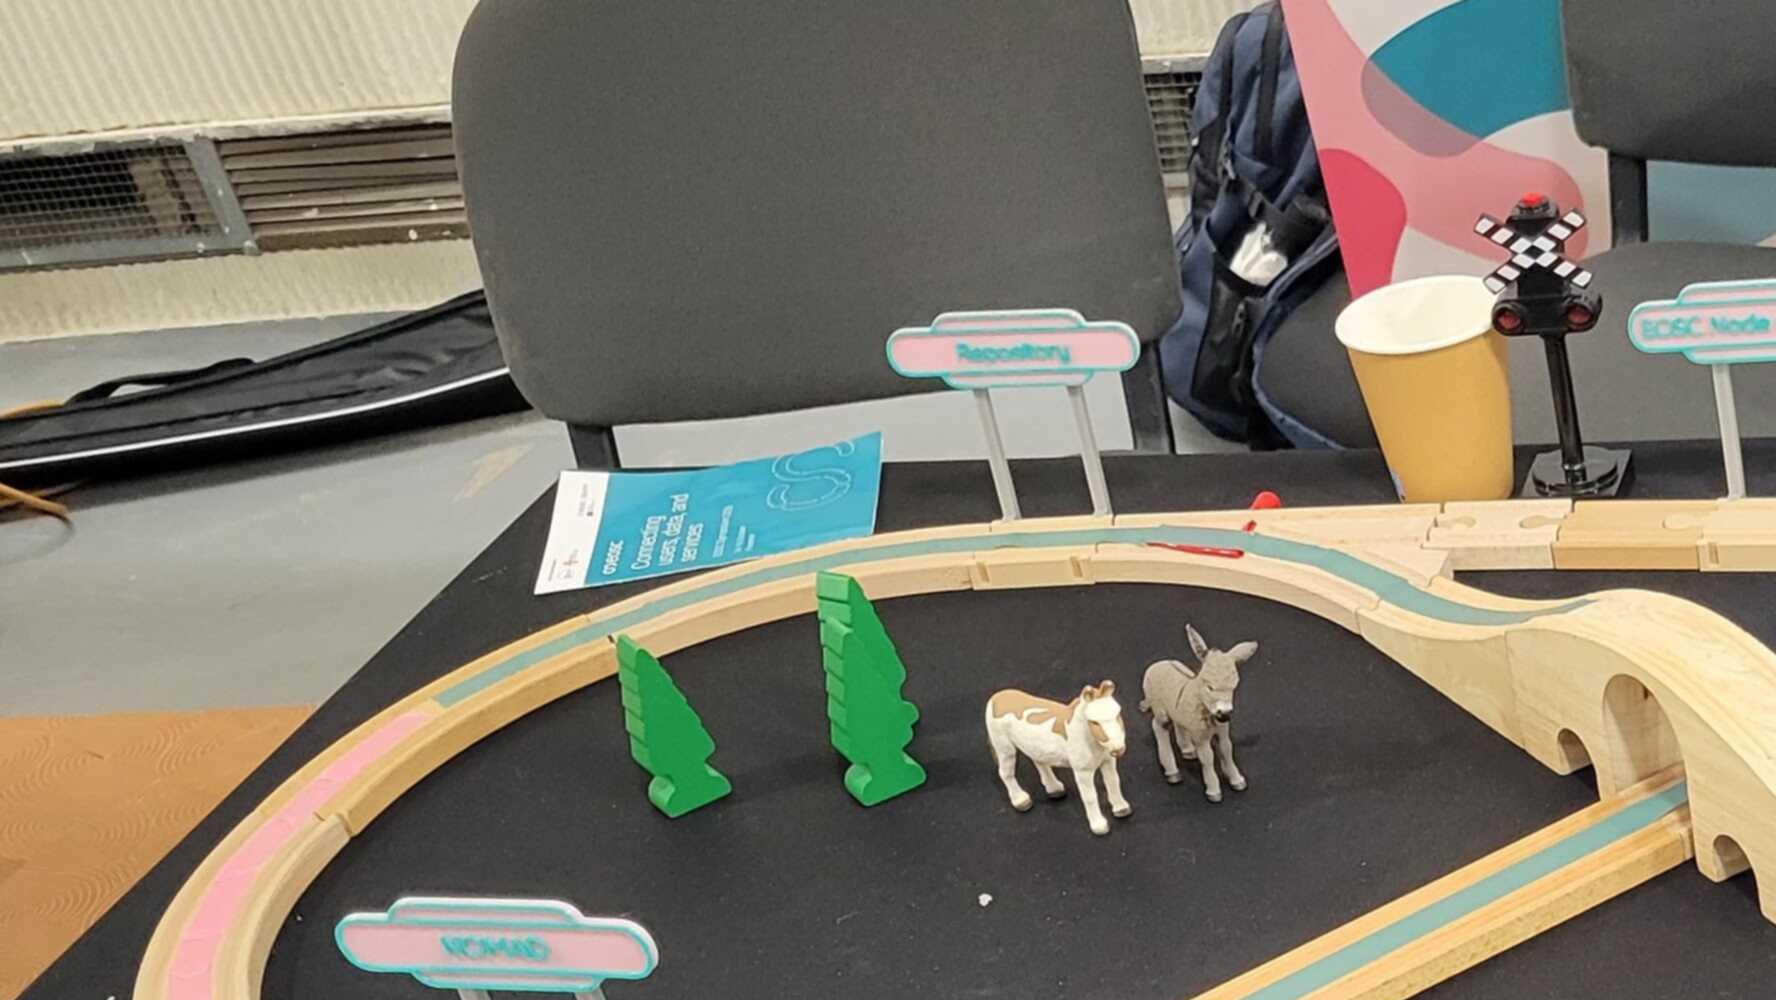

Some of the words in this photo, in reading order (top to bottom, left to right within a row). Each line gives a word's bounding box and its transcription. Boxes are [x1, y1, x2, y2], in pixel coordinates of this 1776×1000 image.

[1641, 316, 1702, 339] EOSC
[1709, 311, 1771, 333] Node
[956, 342, 1071, 364] Repository
[672, 493, 689, 512] and
[665, 512, 687, 537] data,
[631, 515, 666, 570] Connecting
[659, 536, 678, 566] users,
[682, 523, 703, 562] services
